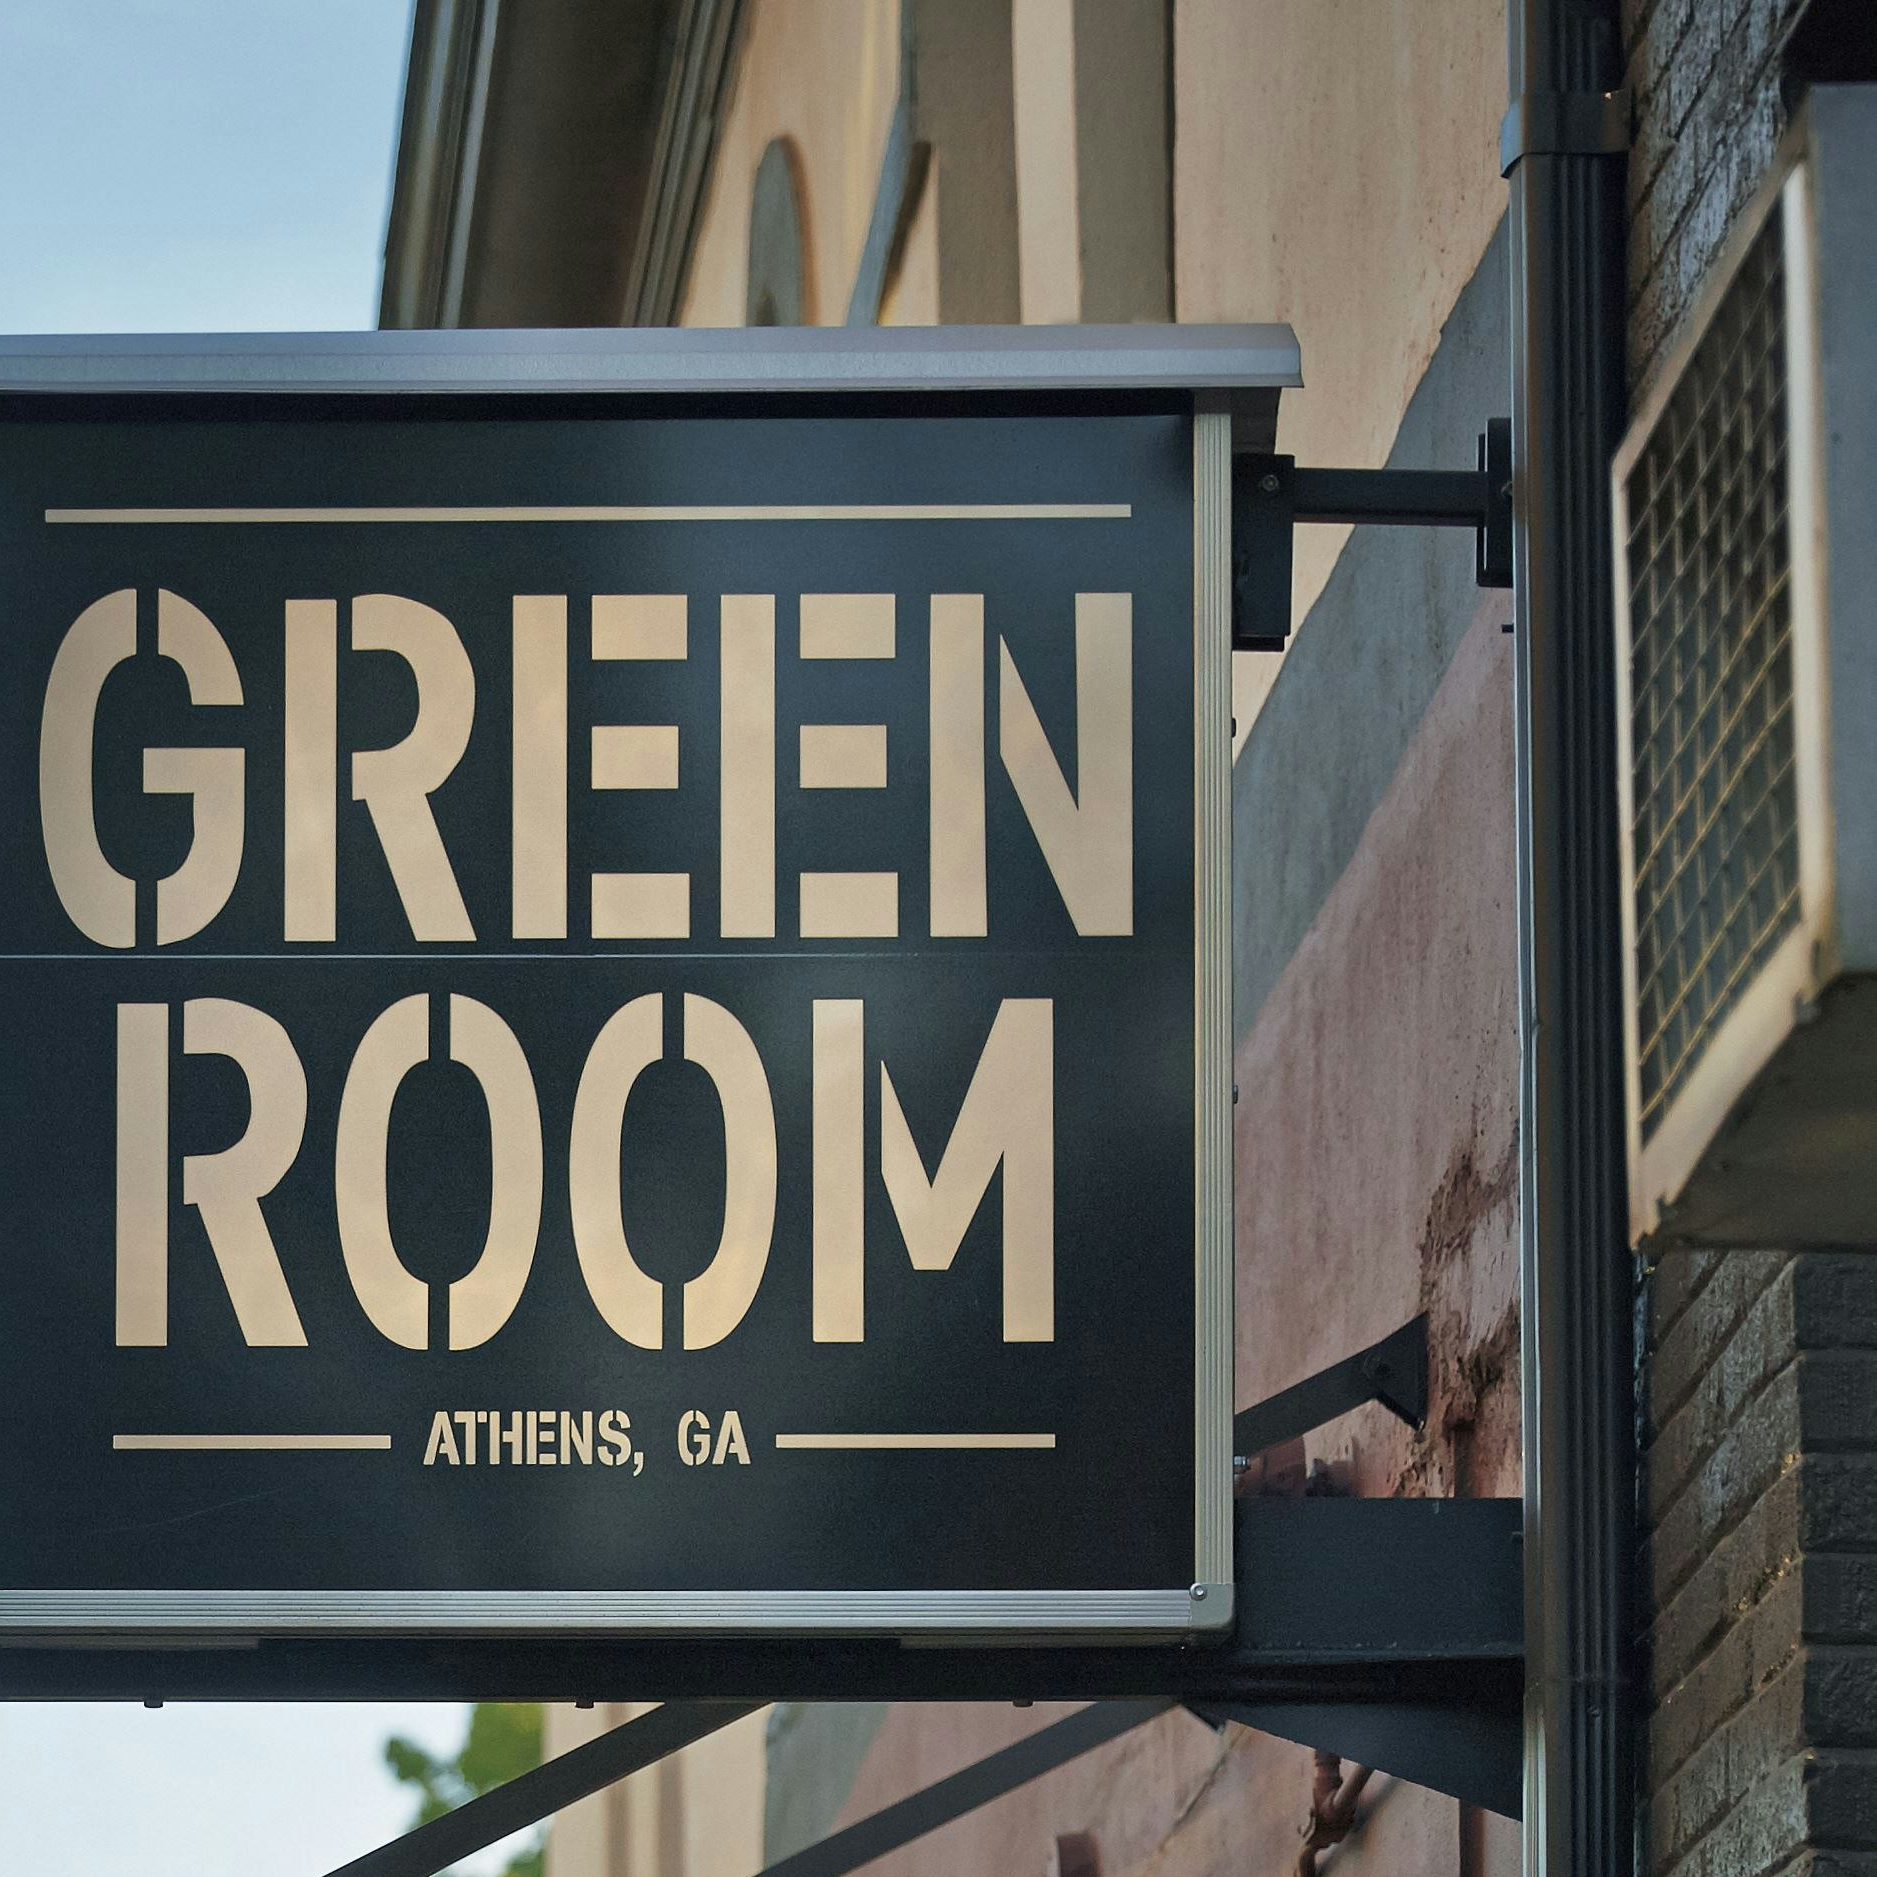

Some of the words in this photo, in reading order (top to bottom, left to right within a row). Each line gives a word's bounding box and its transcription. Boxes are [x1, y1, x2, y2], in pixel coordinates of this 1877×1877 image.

[39, 588, 1133, 949] GREEN
[115, 992, 1054, 1351] ROOM
[423, 1409, 644, 1477] ATHENS,
[677, 1409, 751, 1466] GA
